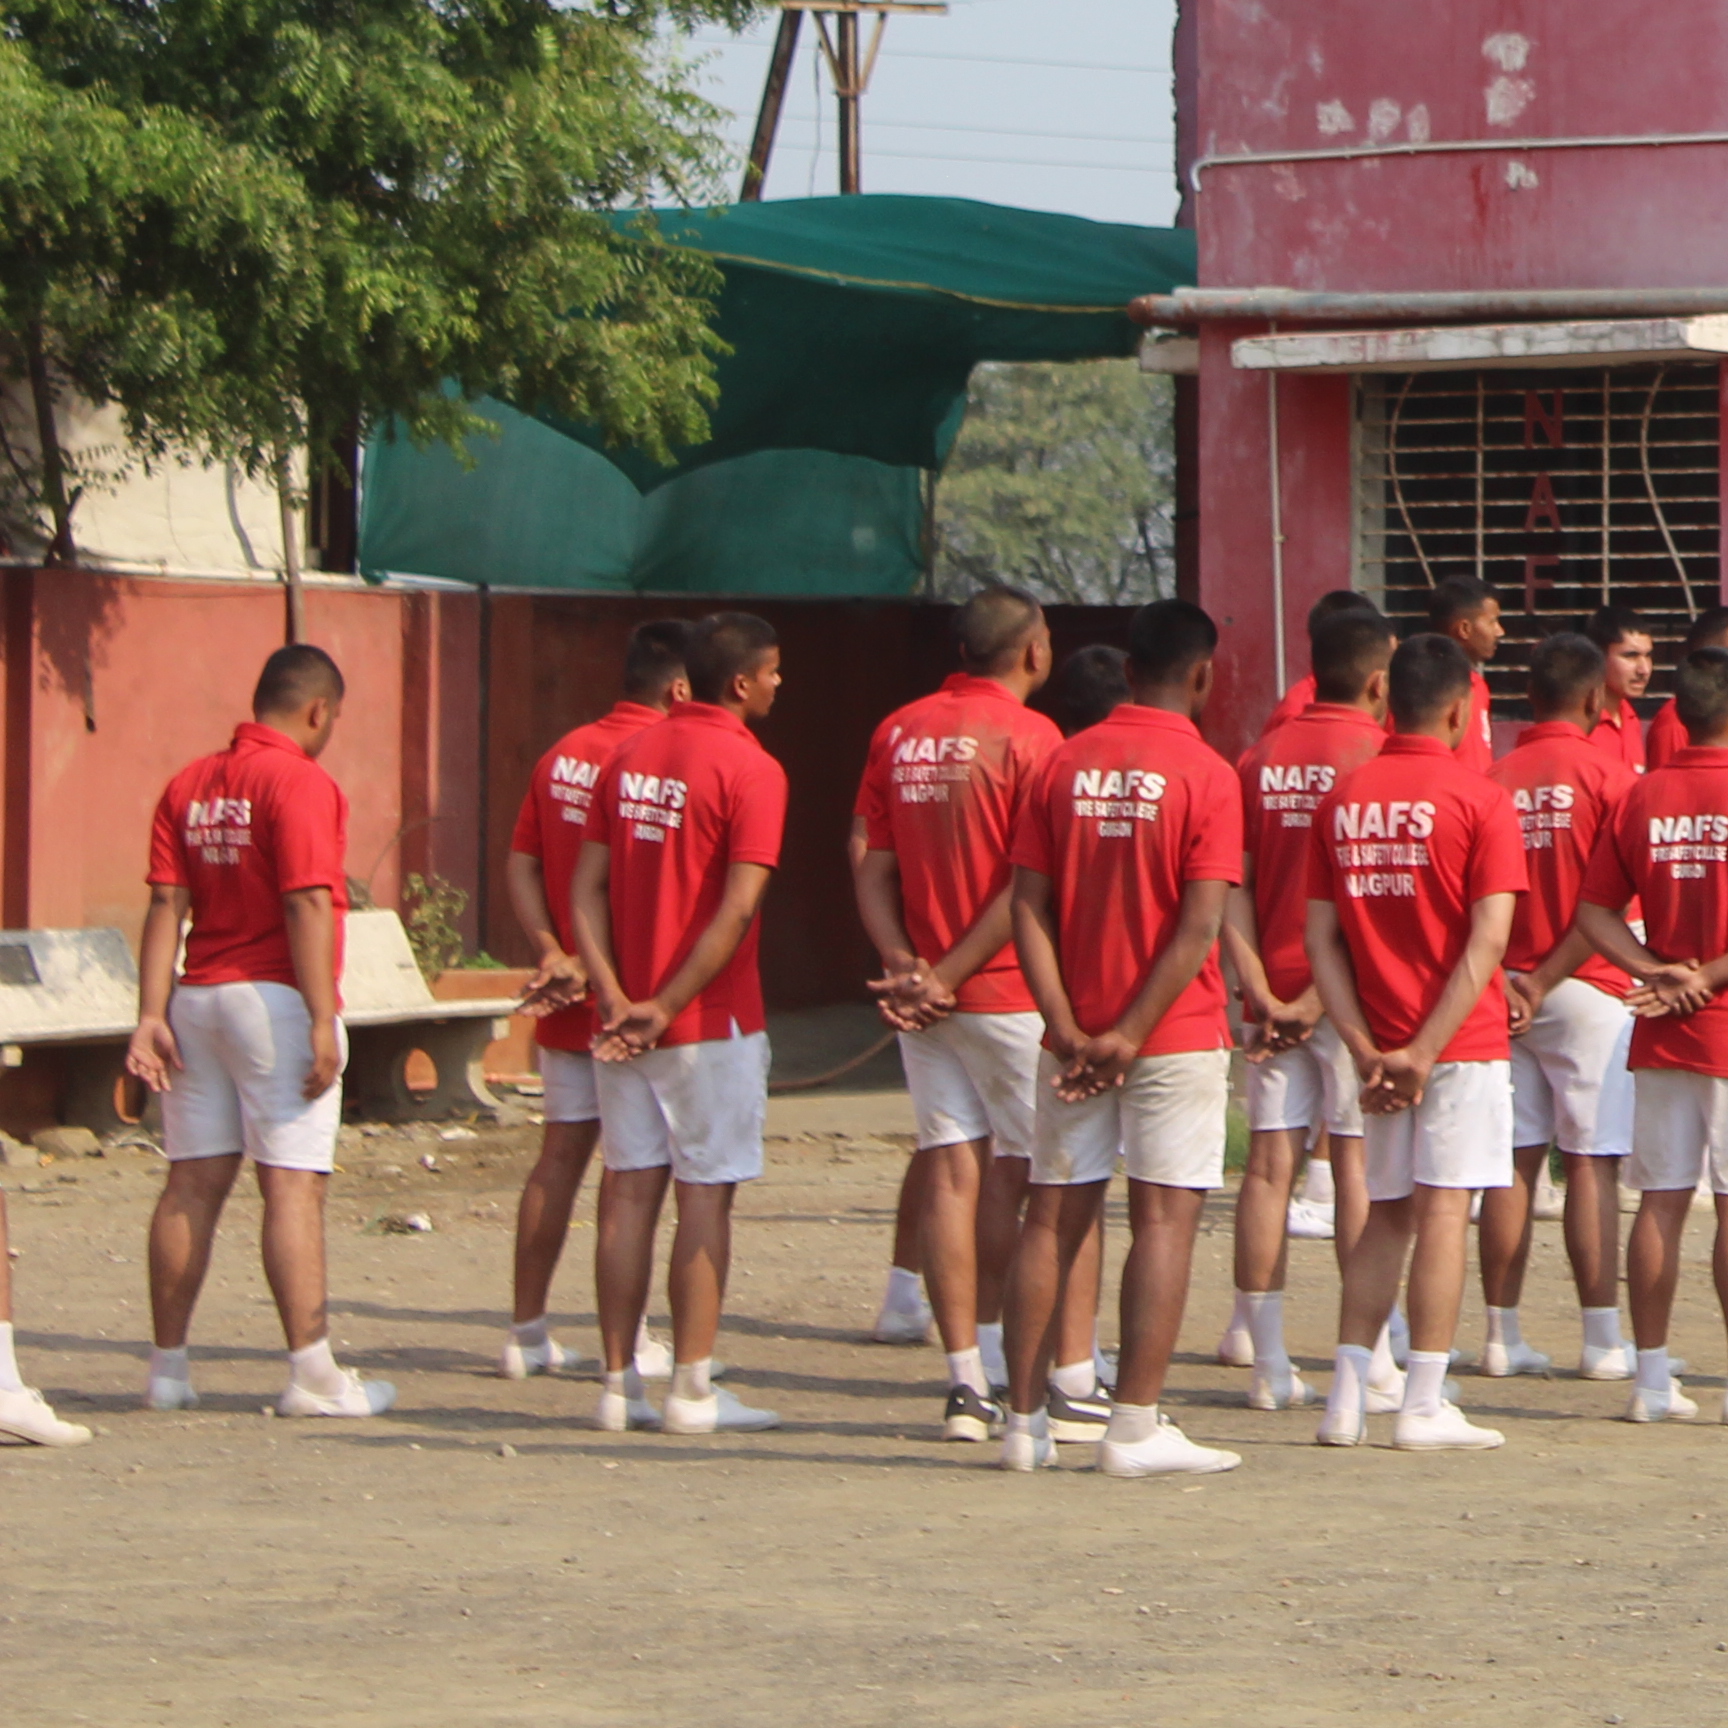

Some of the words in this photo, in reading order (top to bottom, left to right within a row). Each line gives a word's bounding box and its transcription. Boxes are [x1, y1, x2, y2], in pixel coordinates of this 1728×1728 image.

[1524, 388, 1564, 617] NAF
[889, 727, 979, 764] NAFS
[620, 771, 688, 809] NAFS
[1072, 768, 1168, 801] NAFS
[1261, 765, 1337, 792] NAFS
[187, 797, 252, 827] NAFS
[1514, 784, 1575, 812] AFS
[1335, 801, 1436, 841] NAFS
[1345, 873, 1416, 897] NAGPUR
